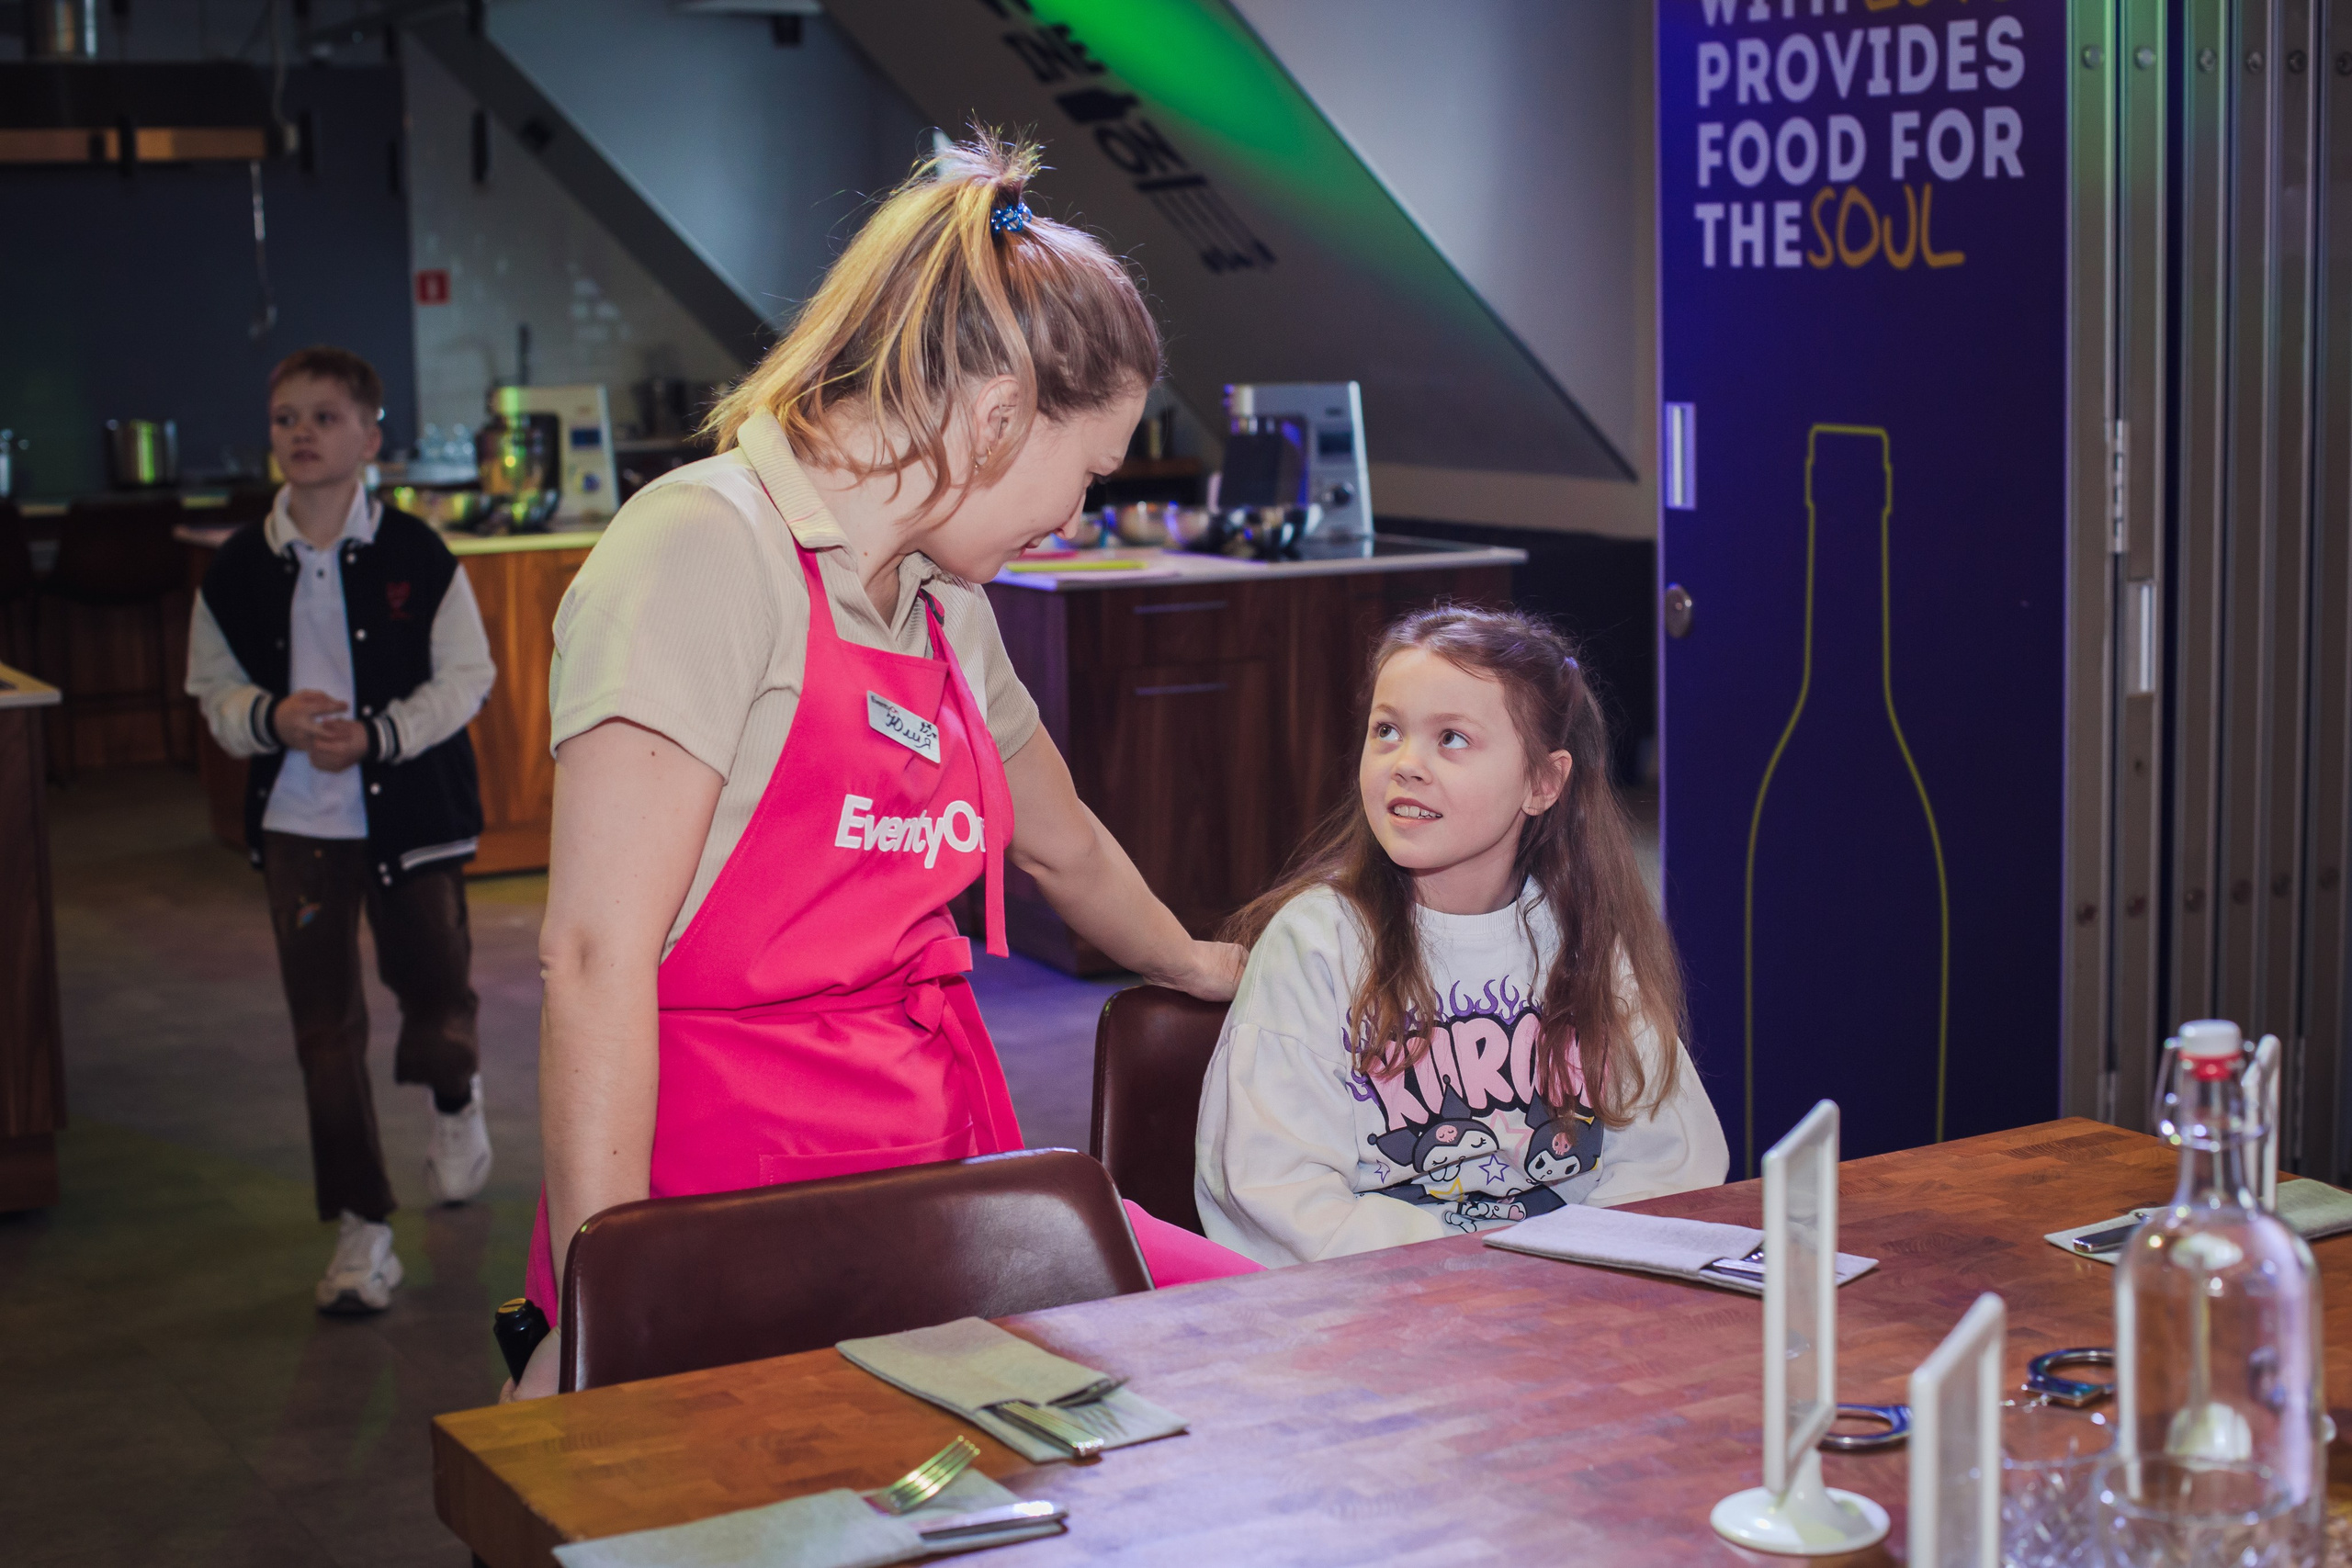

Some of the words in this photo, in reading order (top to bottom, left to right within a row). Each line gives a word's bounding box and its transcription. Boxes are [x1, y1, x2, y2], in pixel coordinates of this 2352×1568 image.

[1697, 15, 2025, 107] PROVIDES
[1697, 114, 1867, 187] FOOD
[1891, 106, 2025, 181] FOR
[1694, 200, 1803, 268] THE
[1807, 183, 1966, 269] SOUL
